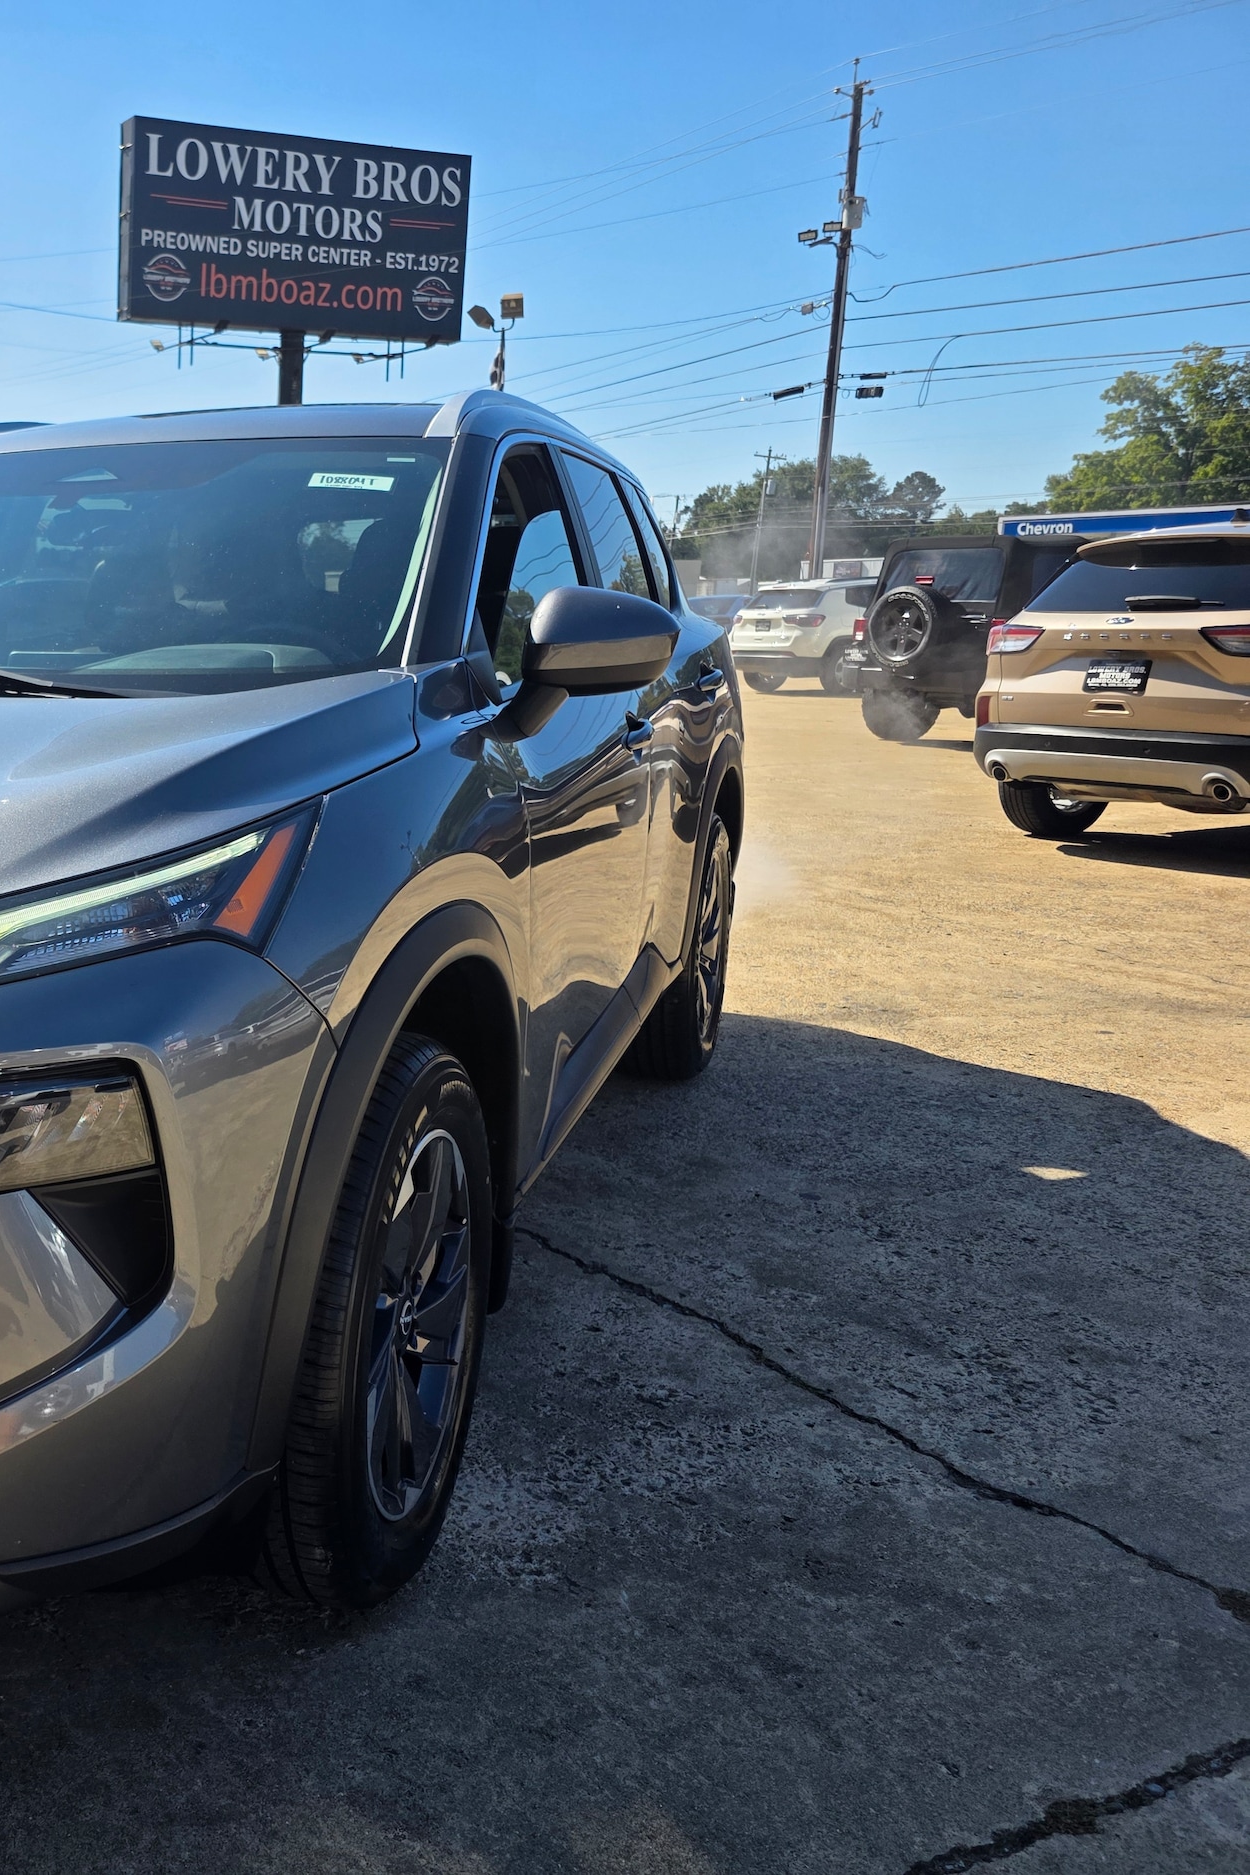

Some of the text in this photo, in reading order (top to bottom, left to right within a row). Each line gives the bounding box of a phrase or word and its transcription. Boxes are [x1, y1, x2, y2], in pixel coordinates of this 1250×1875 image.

[145, 133, 462, 208] LOWERY BROS
[232, 196, 383, 243] MOTORS
[141, 228, 242, 256] PREOWNED
[246, 240, 303, 262] SUPER
[307, 246, 371, 267] CENTER
[386, 252, 459, 274] EST.1972
[200, 263, 403, 312] lbmboaz.com
[1016, 522, 1074, 536] Chevron
